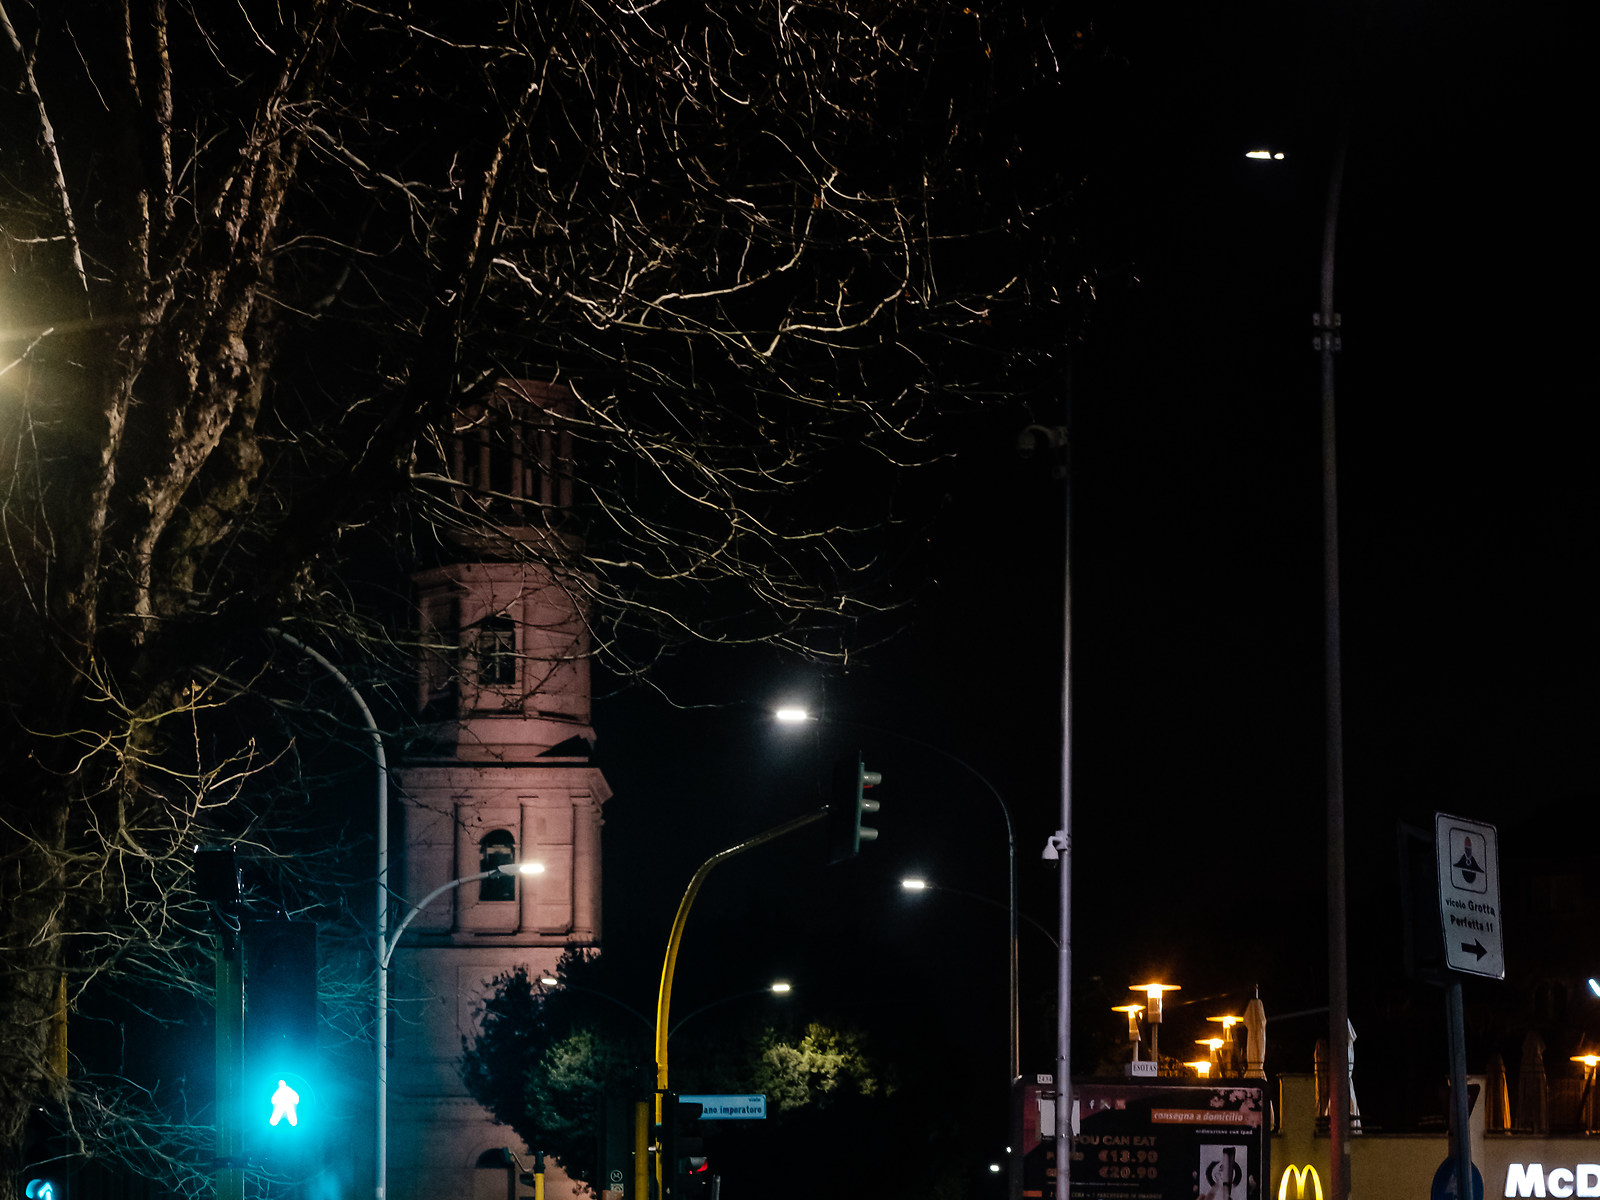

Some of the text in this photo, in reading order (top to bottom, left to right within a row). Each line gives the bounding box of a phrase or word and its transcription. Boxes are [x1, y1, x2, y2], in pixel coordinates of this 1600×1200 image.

[1446, 898, 1495, 917] vicolo Grotta
[1450, 915, 1484, 931] Perfetta
[1154, 1111, 1244, 1122] consegna a domicilio
[1102, 1135, 1130, 1145] CAN
[1133, 1136, 1157, 1146] EAT
